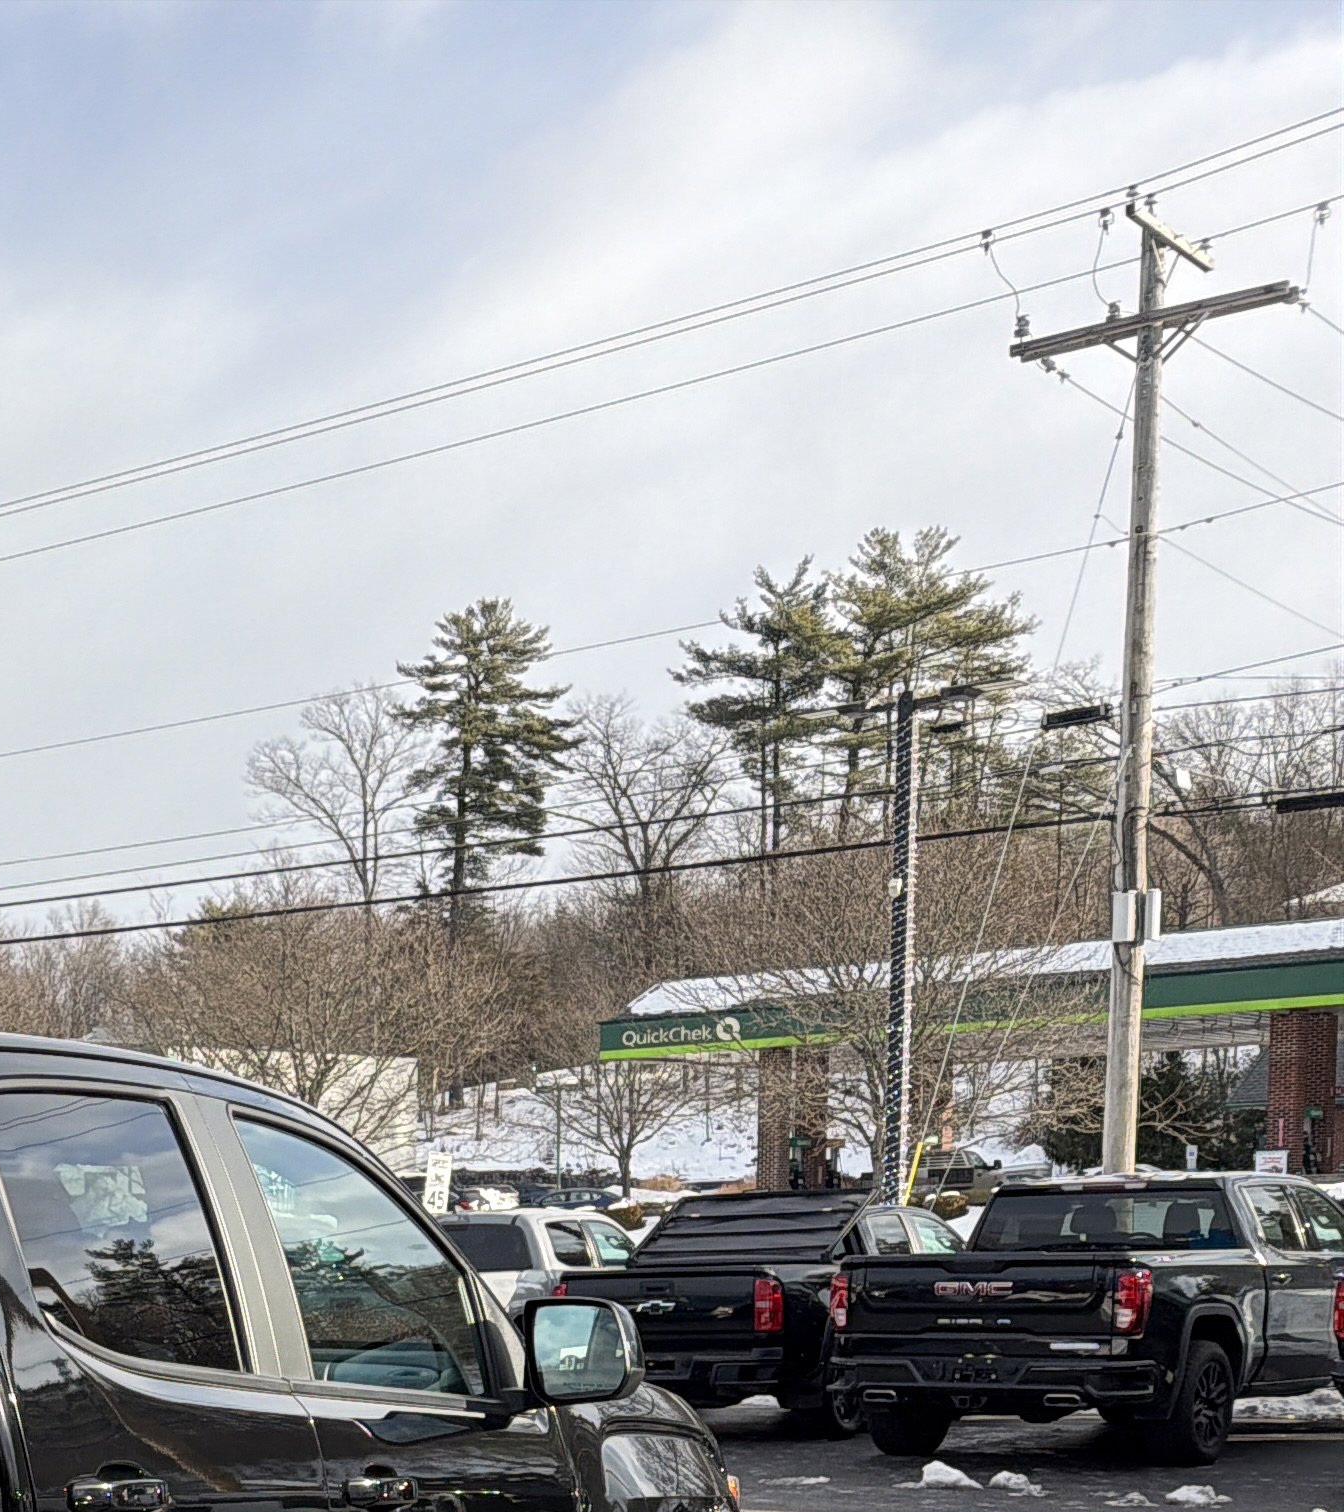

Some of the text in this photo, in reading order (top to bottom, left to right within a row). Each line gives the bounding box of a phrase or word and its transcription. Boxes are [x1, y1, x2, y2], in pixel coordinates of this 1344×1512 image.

[622, 1024, 712, 1047] QuickChek
[427, 1190, 444, 1209] 45
[934, 1281, 1013, 1296] GMC
